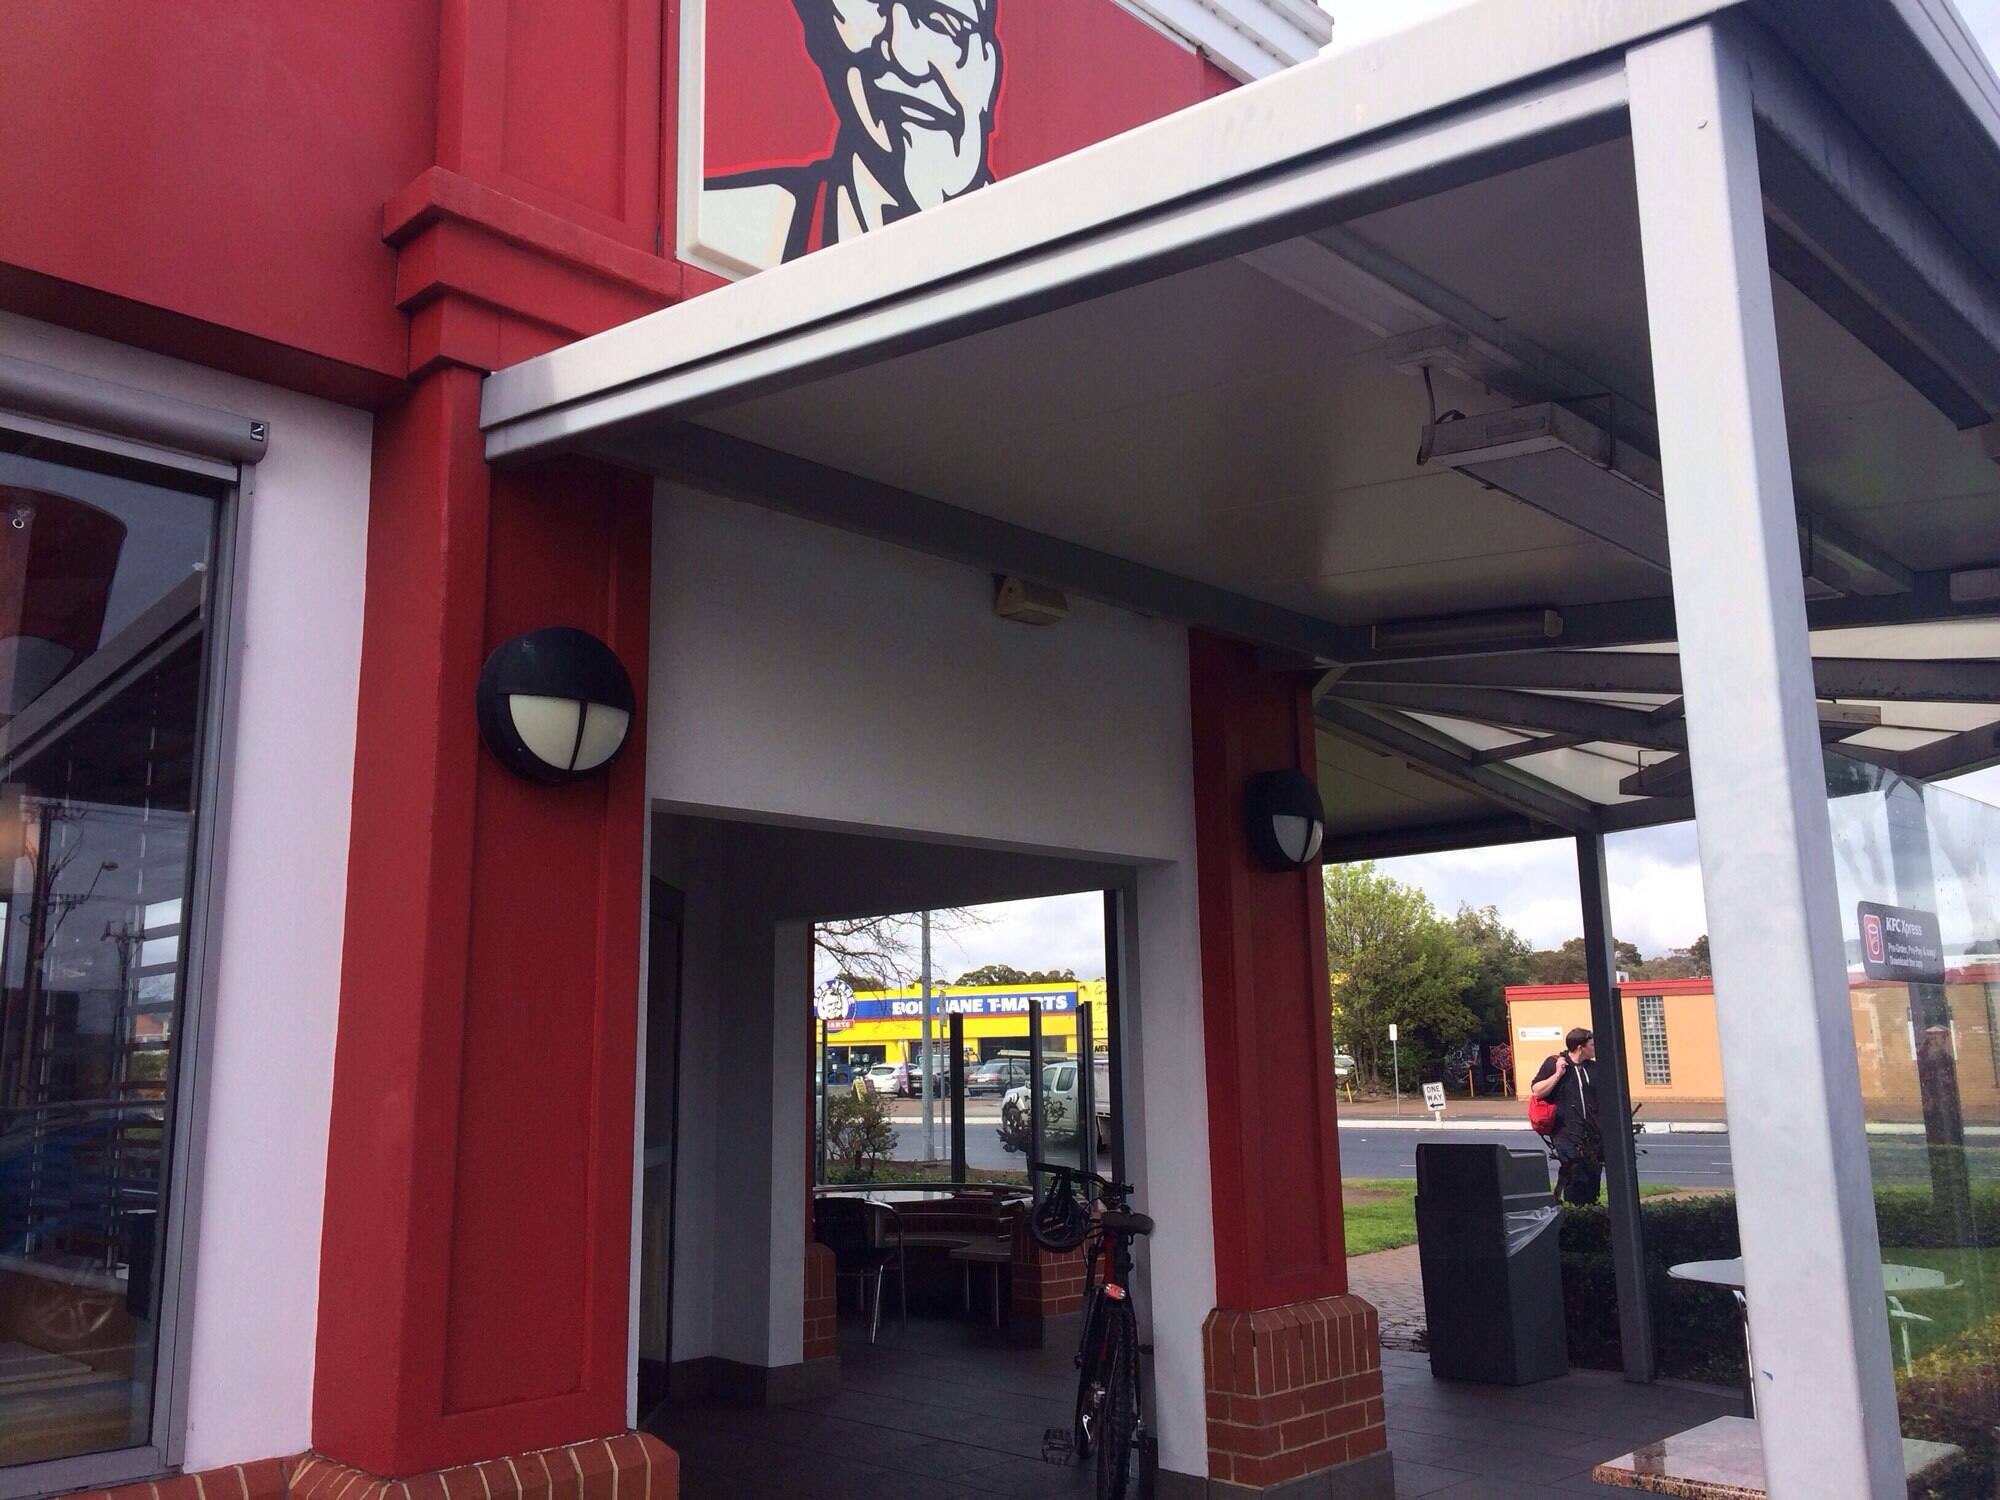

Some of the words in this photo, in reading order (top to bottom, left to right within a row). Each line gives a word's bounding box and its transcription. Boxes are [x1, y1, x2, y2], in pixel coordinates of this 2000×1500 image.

[1886, 917, 1901, 933] KFC
[1901, 919, 1922, 937] Xpress
[1426, 1085, 1440, 1093] ONE
[1427, 1093, 1442, 1102] WAY
